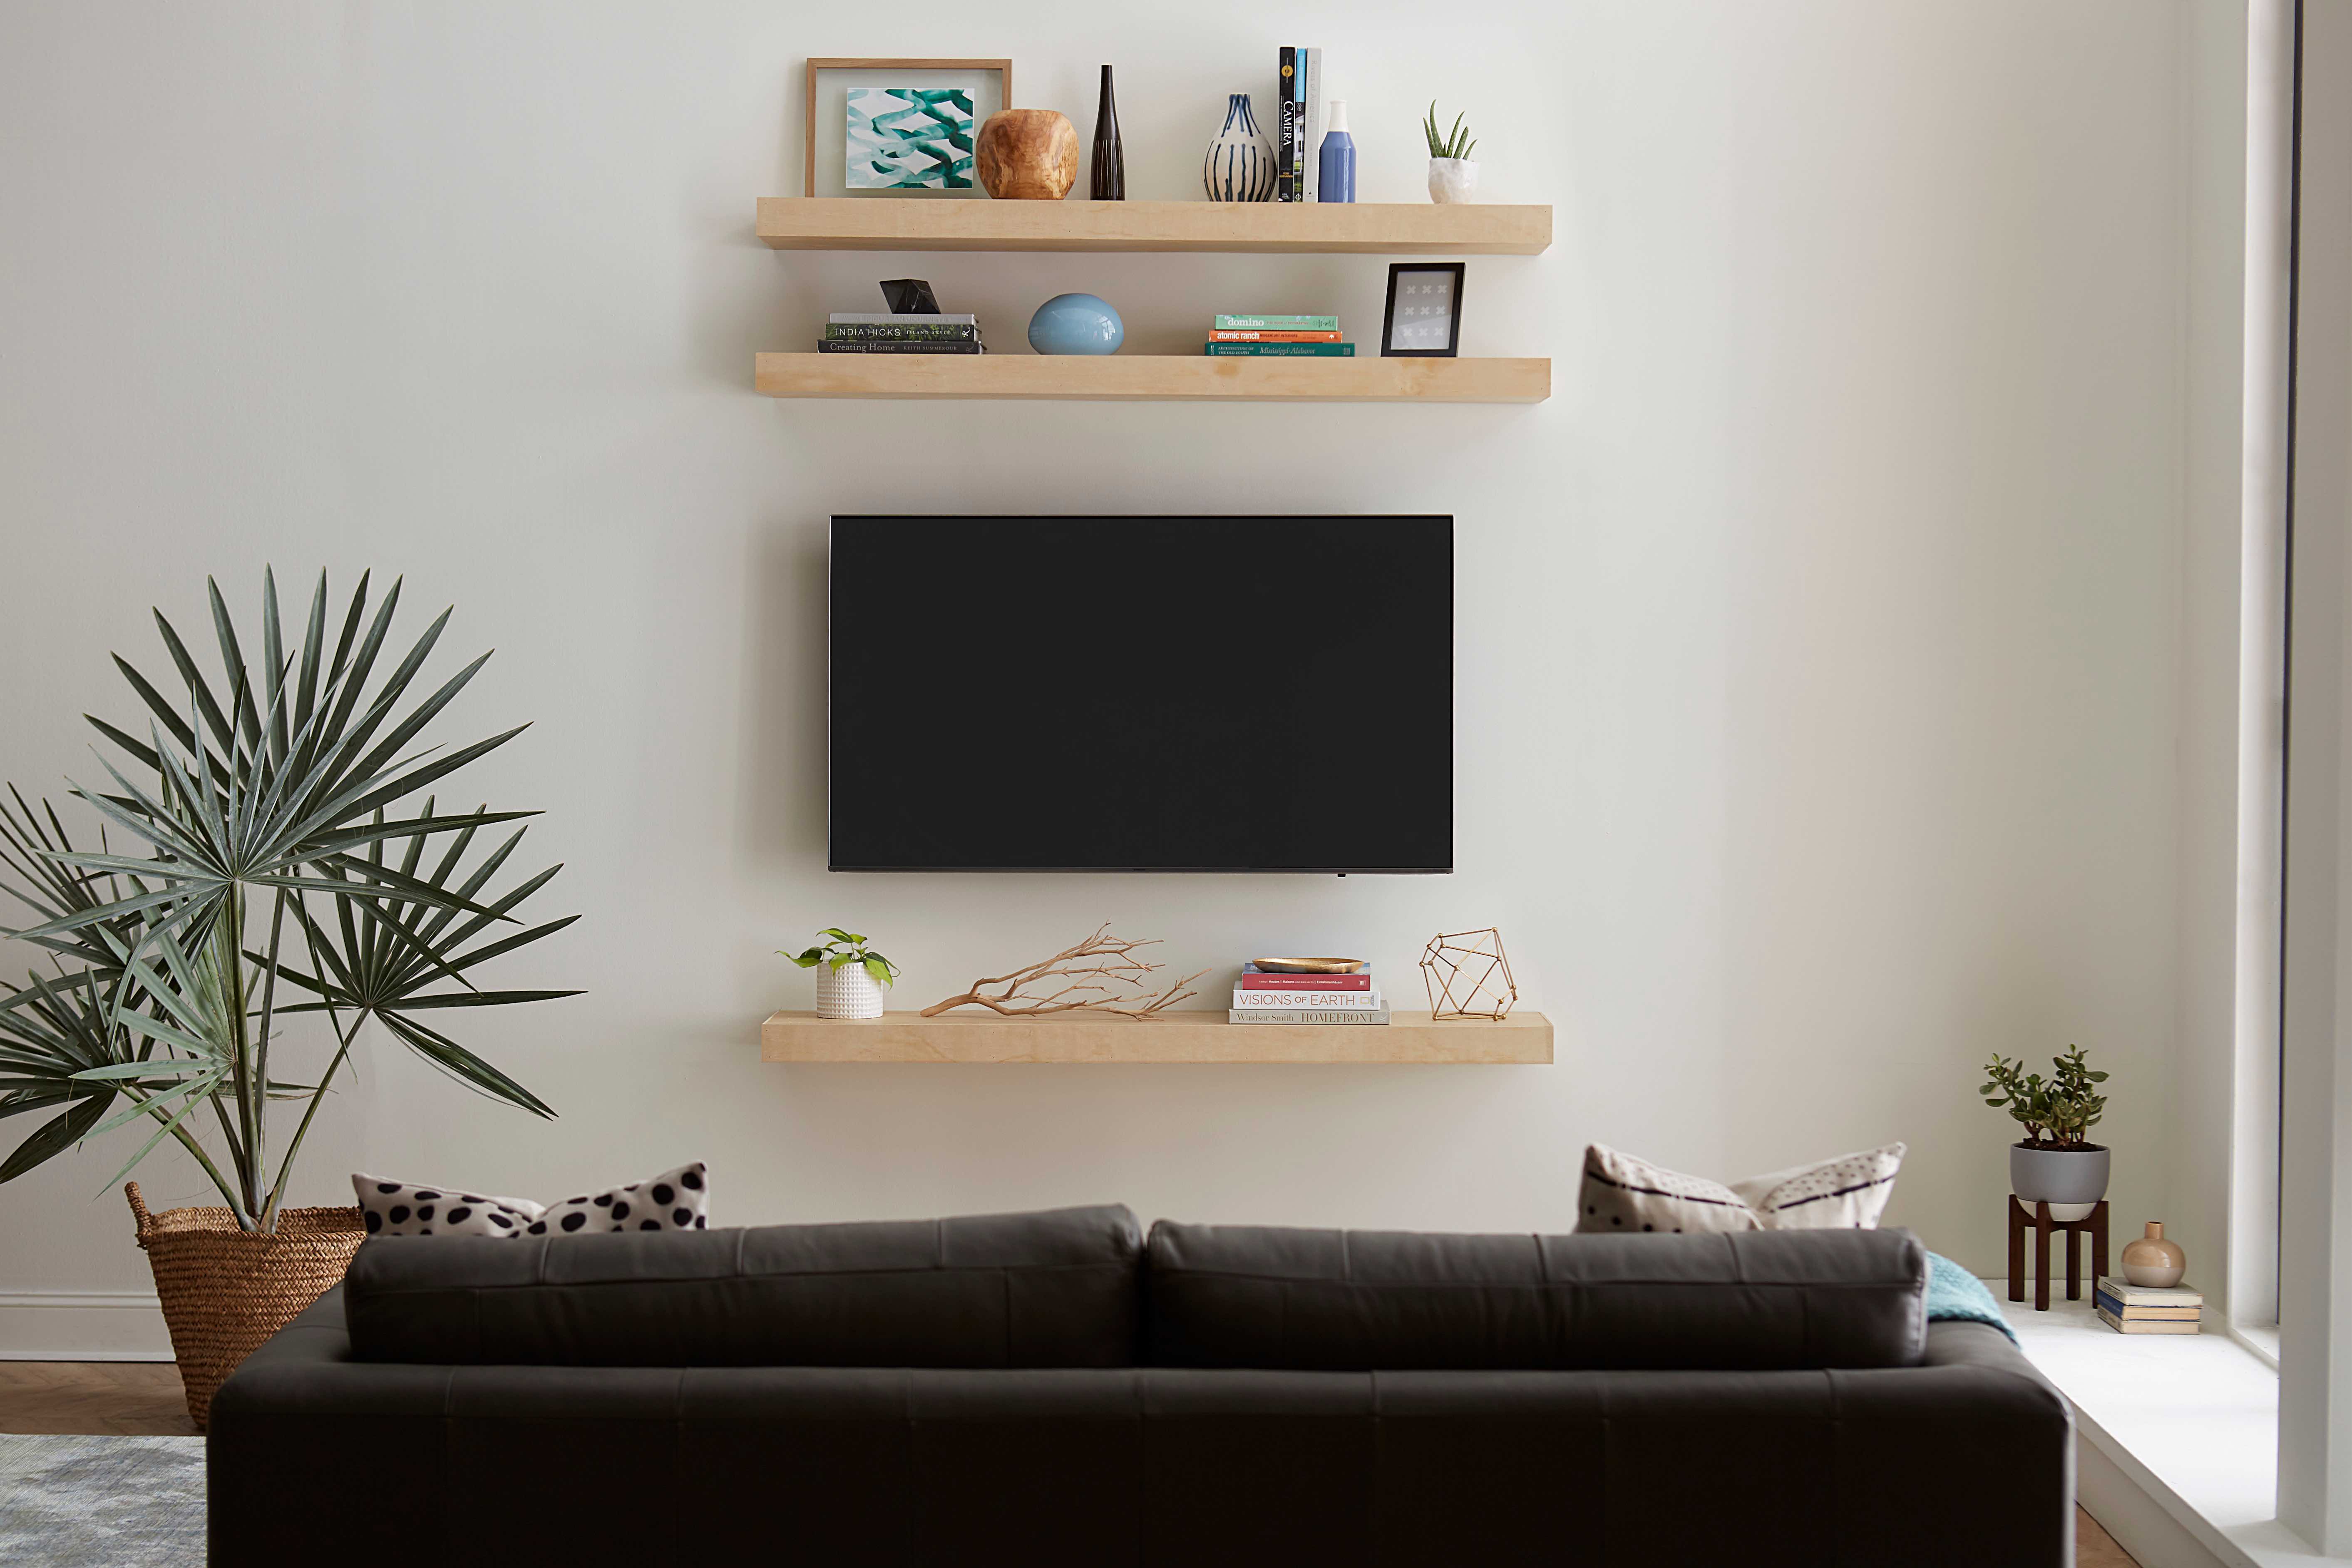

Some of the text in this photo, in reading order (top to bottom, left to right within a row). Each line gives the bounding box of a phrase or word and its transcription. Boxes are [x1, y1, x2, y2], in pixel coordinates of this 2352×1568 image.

[1283, 101, 1293, 146] CAMERA
[1227, 318, 1264, 327] domino
[835, 328, 864, 336] INDIA
[830, 343, 866, 353] Creating
[1239, 994, 1291, 1005] VISIONS
[1311, 995, 1354, 1005] EARTH
[1236, 1012, 1294, 1021] Windsor Smith
[1301, 1012, 1374, 1022] HOMEFRONT
